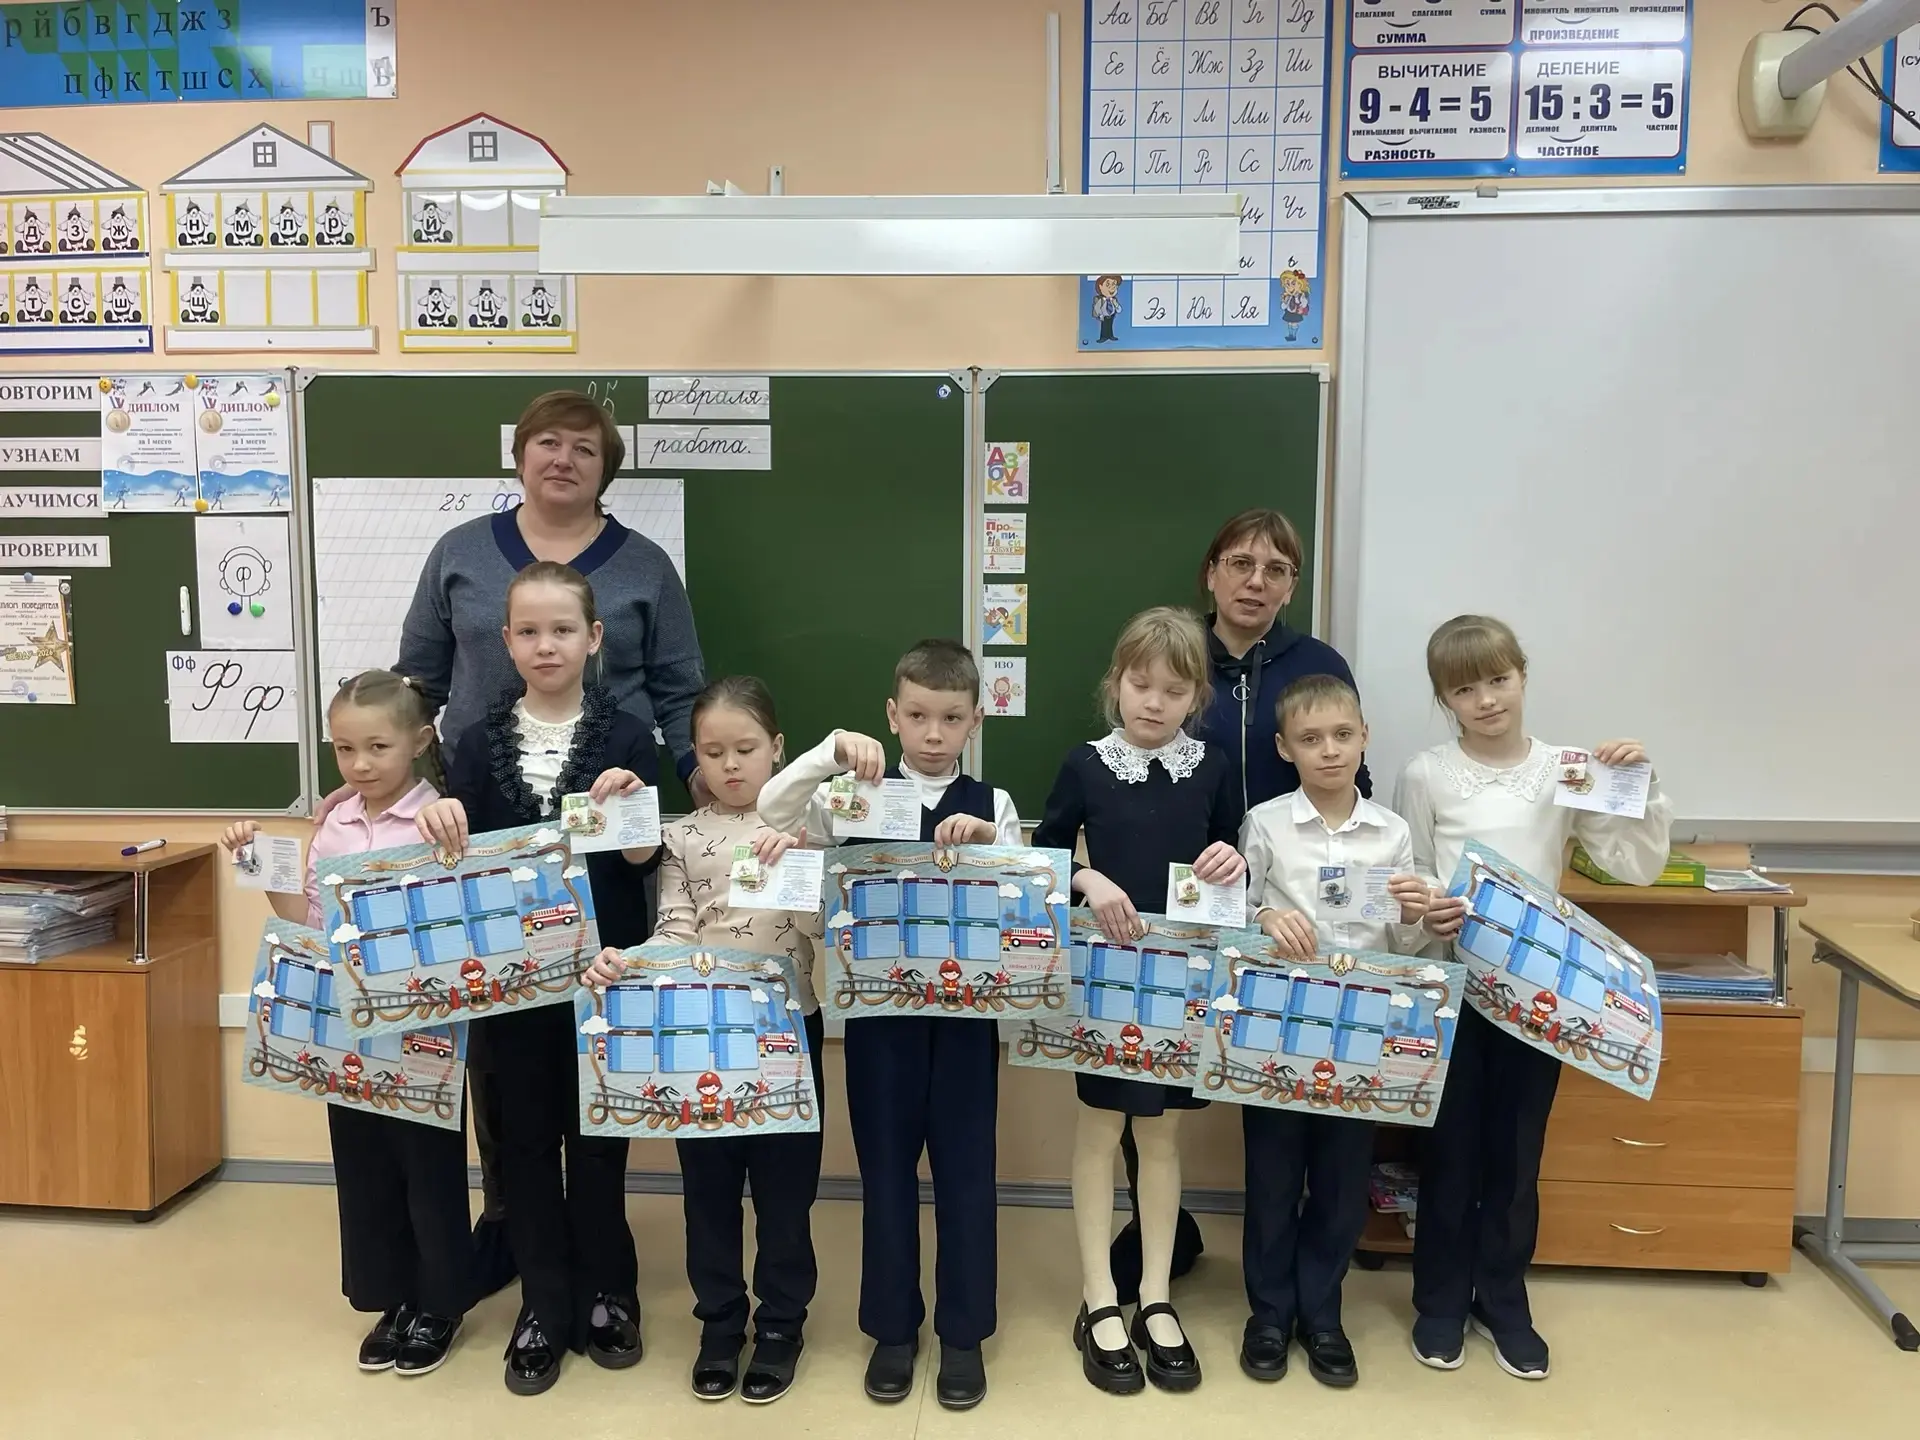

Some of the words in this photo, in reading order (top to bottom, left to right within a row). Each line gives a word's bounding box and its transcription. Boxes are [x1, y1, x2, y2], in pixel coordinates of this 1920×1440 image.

[1099, 1, 1131, 25] Аа
[1146, 1, 1178, 25] Бб
[1195, 1, 1219, 25] Вв
[1479, 8, 1507, 16] СУММА
[1524, 7, 1569, 15] МНОЖИТЕЛЬ
[1629, 5, 1685, 13] ПРОИЗВЕДЕНИЕ
[1376, 33, 1427, 44] СУММА
[1529, 28, 1620, 41] ПРОИЗВЕДЕНИЕ
[1105, 51, 1124, 75] Ее
[1188, 50, 1223, 74] Жж
[1241, 48, 1264, 83] Зз
[1285, 48, 1312, 72] Ии
[1378, 64, 1487, 79] ВЫЧИТАНИЕ
[1537, 61, 1620, 78] ДЕЛЕНИЕ
[1359, 87, 1381, 124] 9
[1409, 86, 1431, 122] 4
[1470, 86, 1492, 122] 5
[1524, 84, 1564, 121] 15
[1589, 83, 1611, 120] 3
[1652, 83, 1674, 119] 5
[1146, 100, 1172, 124] Кк
[1283, 99, 1312, 124] Нн
[1352, 128, 1405, 136] УМЕНЬШАЕМОЕ
[1409, 127, 1457, 135] ВЫЧИТАЕМОЕ
[1525, 126, 1560, 134] ДЕЛИМОЕ
[1580, 125, 1618, 133] ДЕЛИТЕЛЬ
[1365, 149, 1436, 160] РАЗНОСТЬ
[1538, 145, 1600, 157] ЧАСТНОЕ
[1145, 149, 1172, 174] Пп
[1278, 148, 1314, 172] Тт
[1186, 296, 1212, 320] Юю
[1231, 296, 1259, 319] Яя
[654, 379, 762, 415] февраля
[128, 403, 180, 413] ДИПЛОМ
[650, 427, 751, 464] работа.
[3, 448, 81, 463] УЗНАЕМ
[439, 493, 472, 511] 25
[994, 661, 1014, 669] ИЗО
